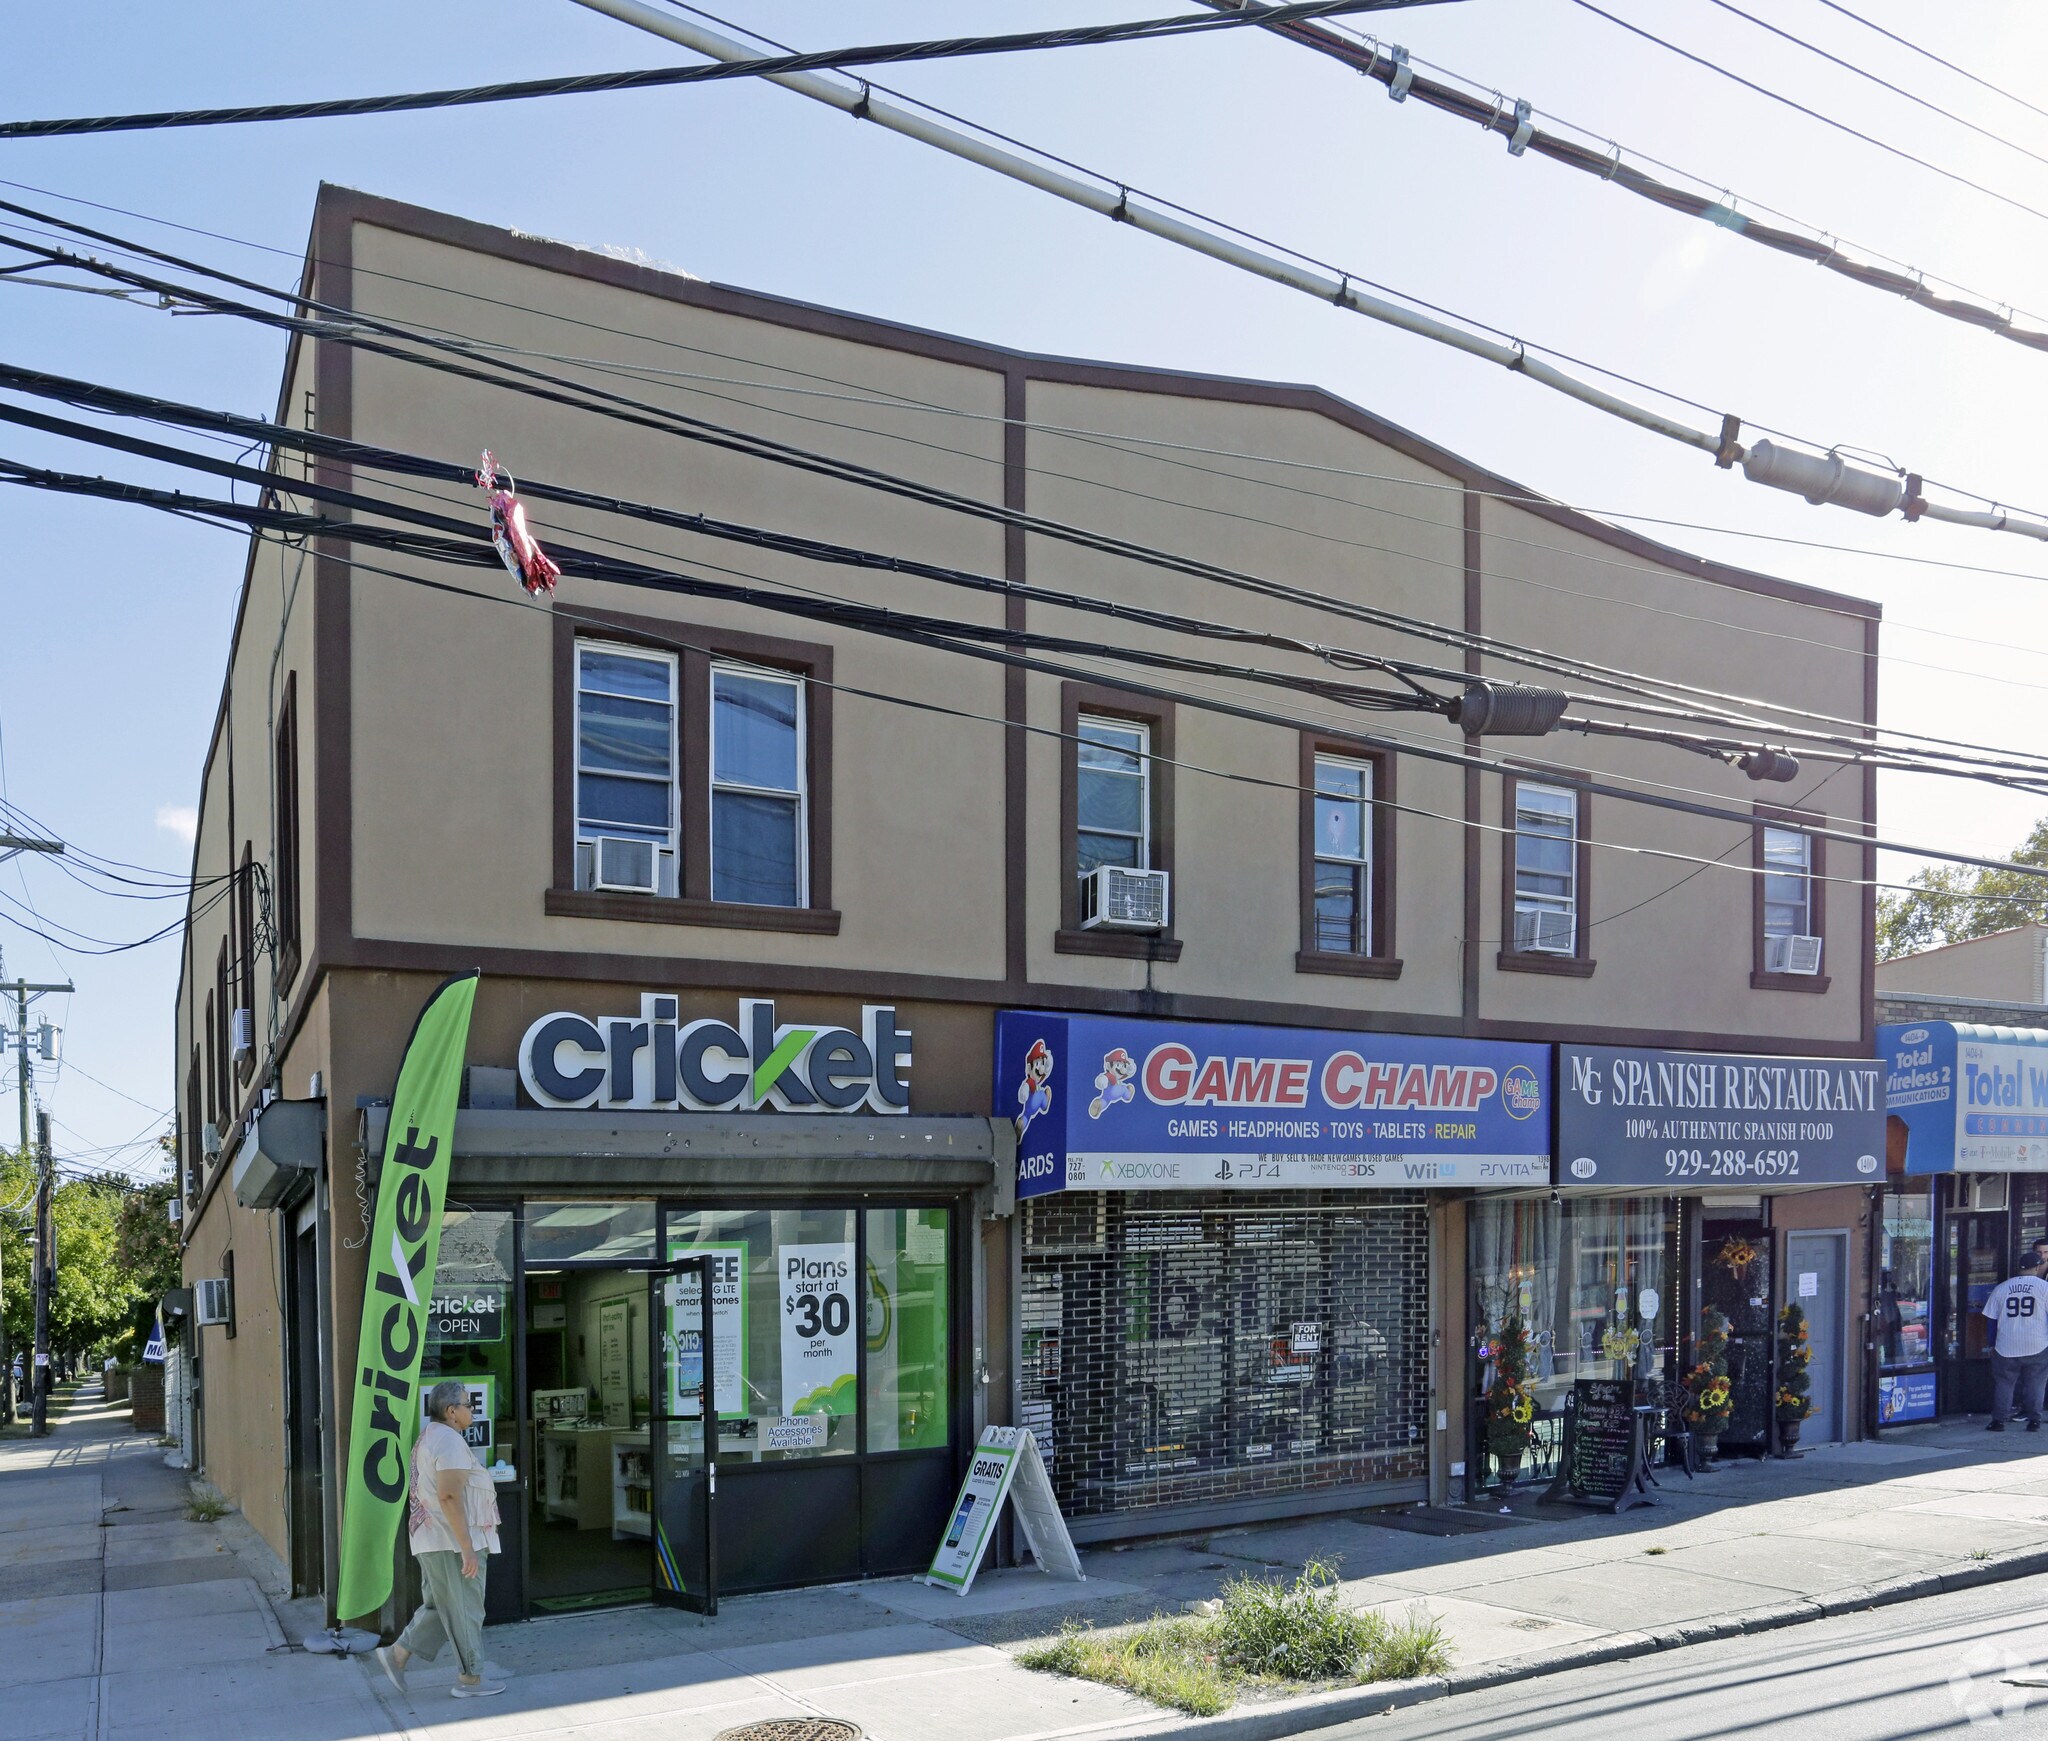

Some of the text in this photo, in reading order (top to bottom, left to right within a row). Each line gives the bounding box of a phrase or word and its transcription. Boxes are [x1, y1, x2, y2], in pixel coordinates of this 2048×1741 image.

[519, 994, 912, 1112] cricket
[1896, 1045, 1933, 1069] Total
[1143, 1043, 1498, 1111] GAME CHAMP
[1942, 1066, 1950, 1083] 2
[1965, 1059, 2023, 1107] Total
[1505, 1078, 1539, 1097] GAME
[1612, 1058, 1718, 1109] SPANISH
[1723, 1065, 1879, 1112] RESTAURANT
[1512, 1095, 1540, 1112] Champ
[1167, 1119, 1477, 1140] GAMES HEADPHONES TOYS TABLETS REPAIR
[1625, 1119, 1834, 1141] 100% AUTHENTIC SPANISH FOOD
[1017, 1152, 1054, 1181] ARDS
[1258, 1154, 1268, 1162] WE
[1286, 1154, 1299, 1162] SELL
[1301, 1154, 1306, 1162] &
[1308, 1154, 1325, 1162] TRADE
[1327, 1154, 1341, 1162] NEW
[1342, 1154, 1361, 1162] GAMES
[1362, 1154, 1367, 1162] &
[1367, 1154, 1382, 1162] USED
[1384, 1154, 1404, 1162] GAMES
[1665, 1149, 1799, 1176] 929-288-6592
[1860, 1156, 1875, 1172] 1400
[1239, 1164, 1281, 1178] PS4
[1348, 1164, 1375, 1177] 3DS
[1404, 1163, 1437, 1179] Wii
[1575, 1161, 1593, 1175] 1400
[787, 1257, 848, 1280] Plans
[679, 1286, 703, 1295] selec
[723, 1285, 736, 1293] LTE
[795, 1280, 839, 1294] start at
[2008, 1283, 2033, 1295] JUDGE
[363, 1126, 438, 1503] cricket
[786, 1292, 850, 1339] $30
[2006, 1296, 2035, 1318] 99
[438, 1318, 480, 1333] OPEN
[1298, 1325, 1316, 1333] FOR
[810, 1339, 826, 1352] per
[1294, 1333, 1319, 1342] RENT
[803, 1347, 832, 1359] month
[461, 1425, 483, 1443] PEN
[768, 1425, 823, 1437] Accessories
[770, 1436, 814, 1447] Available!
[973, 1460, 1005, 1479] GRATIS
